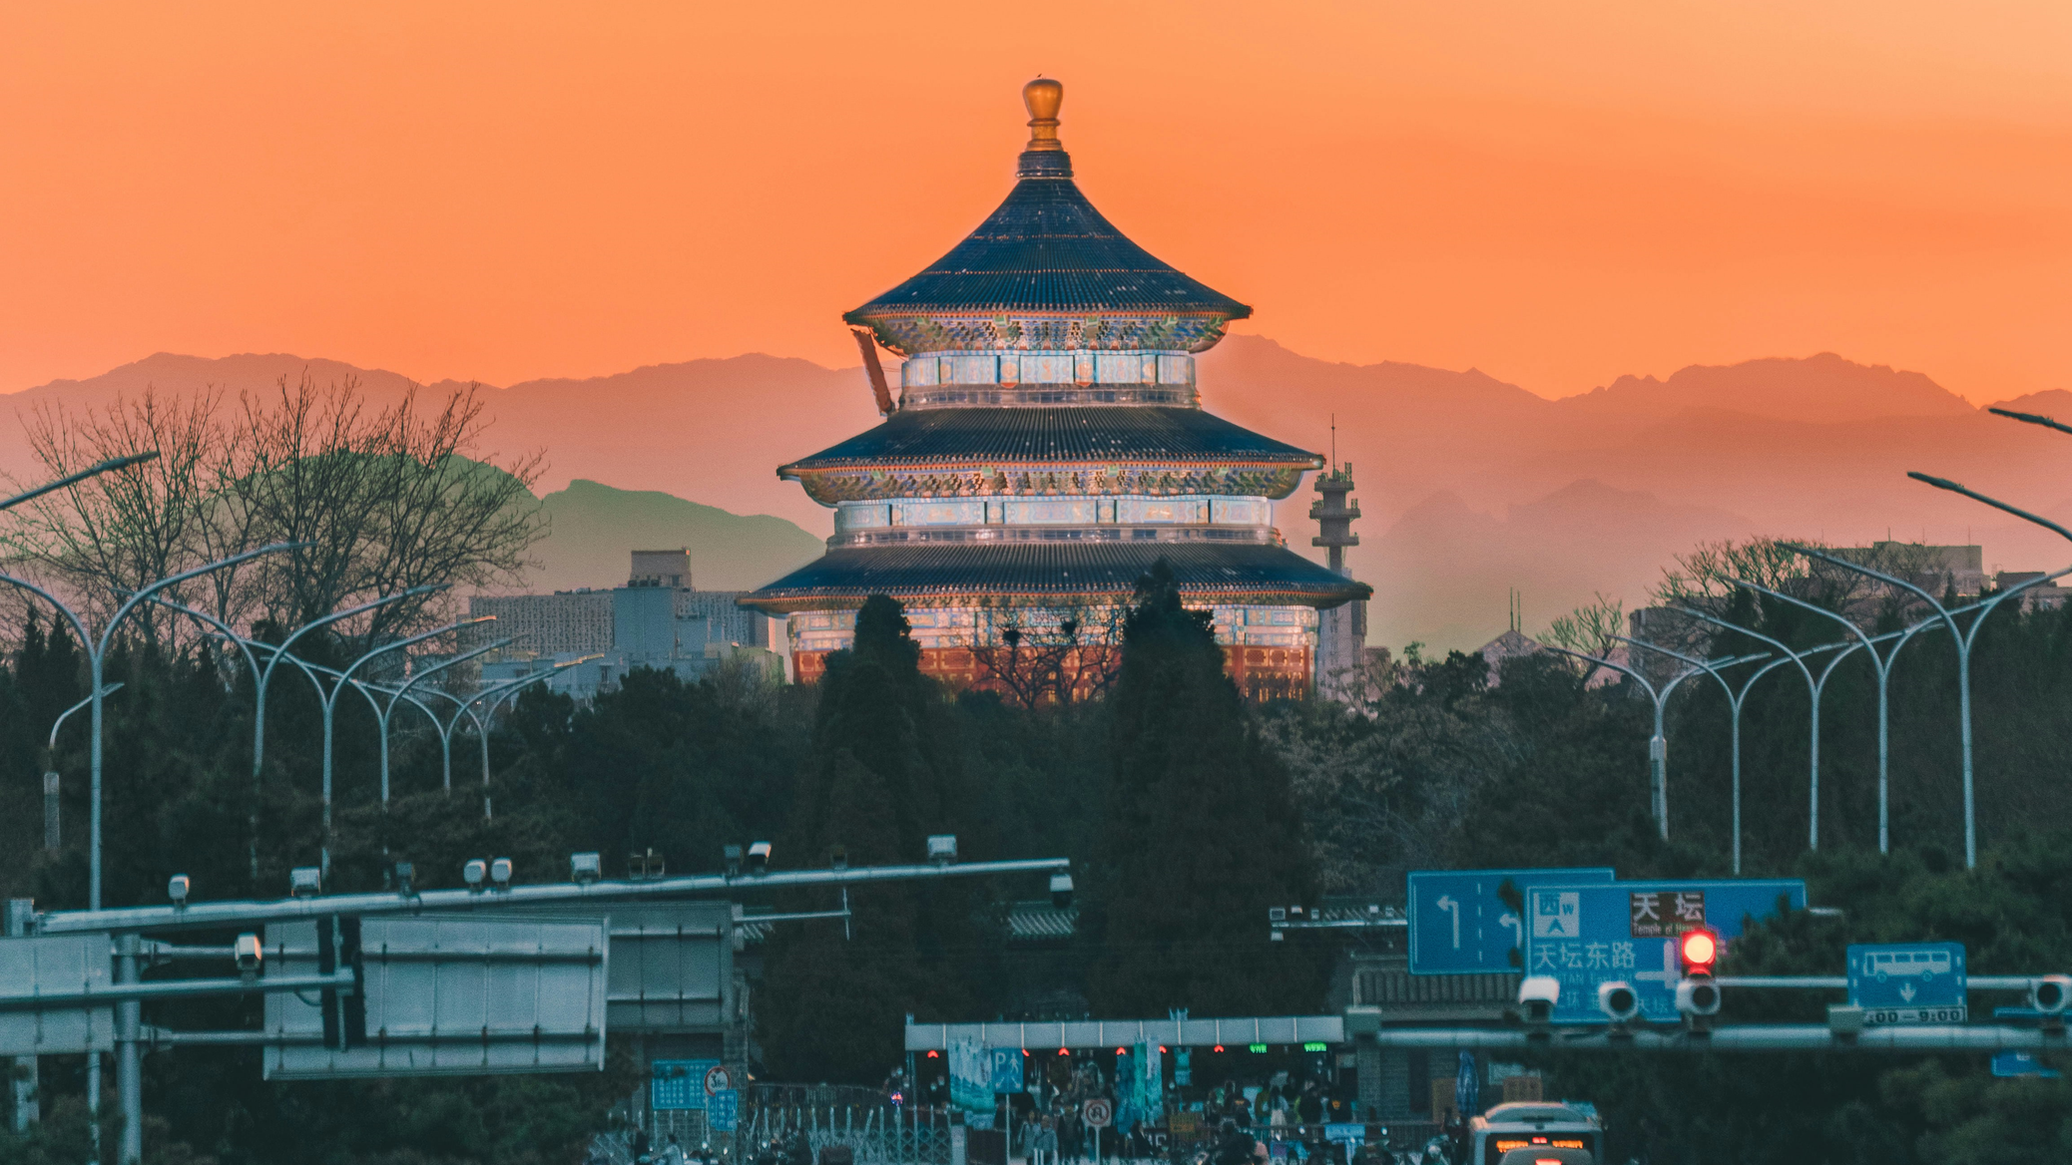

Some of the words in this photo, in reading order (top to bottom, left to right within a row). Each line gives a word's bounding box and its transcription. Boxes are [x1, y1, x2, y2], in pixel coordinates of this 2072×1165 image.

[1539, 893, 1561, 916] 西
[1562, 903, 1574, 915] W
[1633, 892, 1703, 921] 天坛
[1633, 922, 1662, 935] Temple
[1665, 923, 1674, 935] of
[1534, 941, 1635, 969] 天坛东路
[995, 1052, 1006, 1072] P
